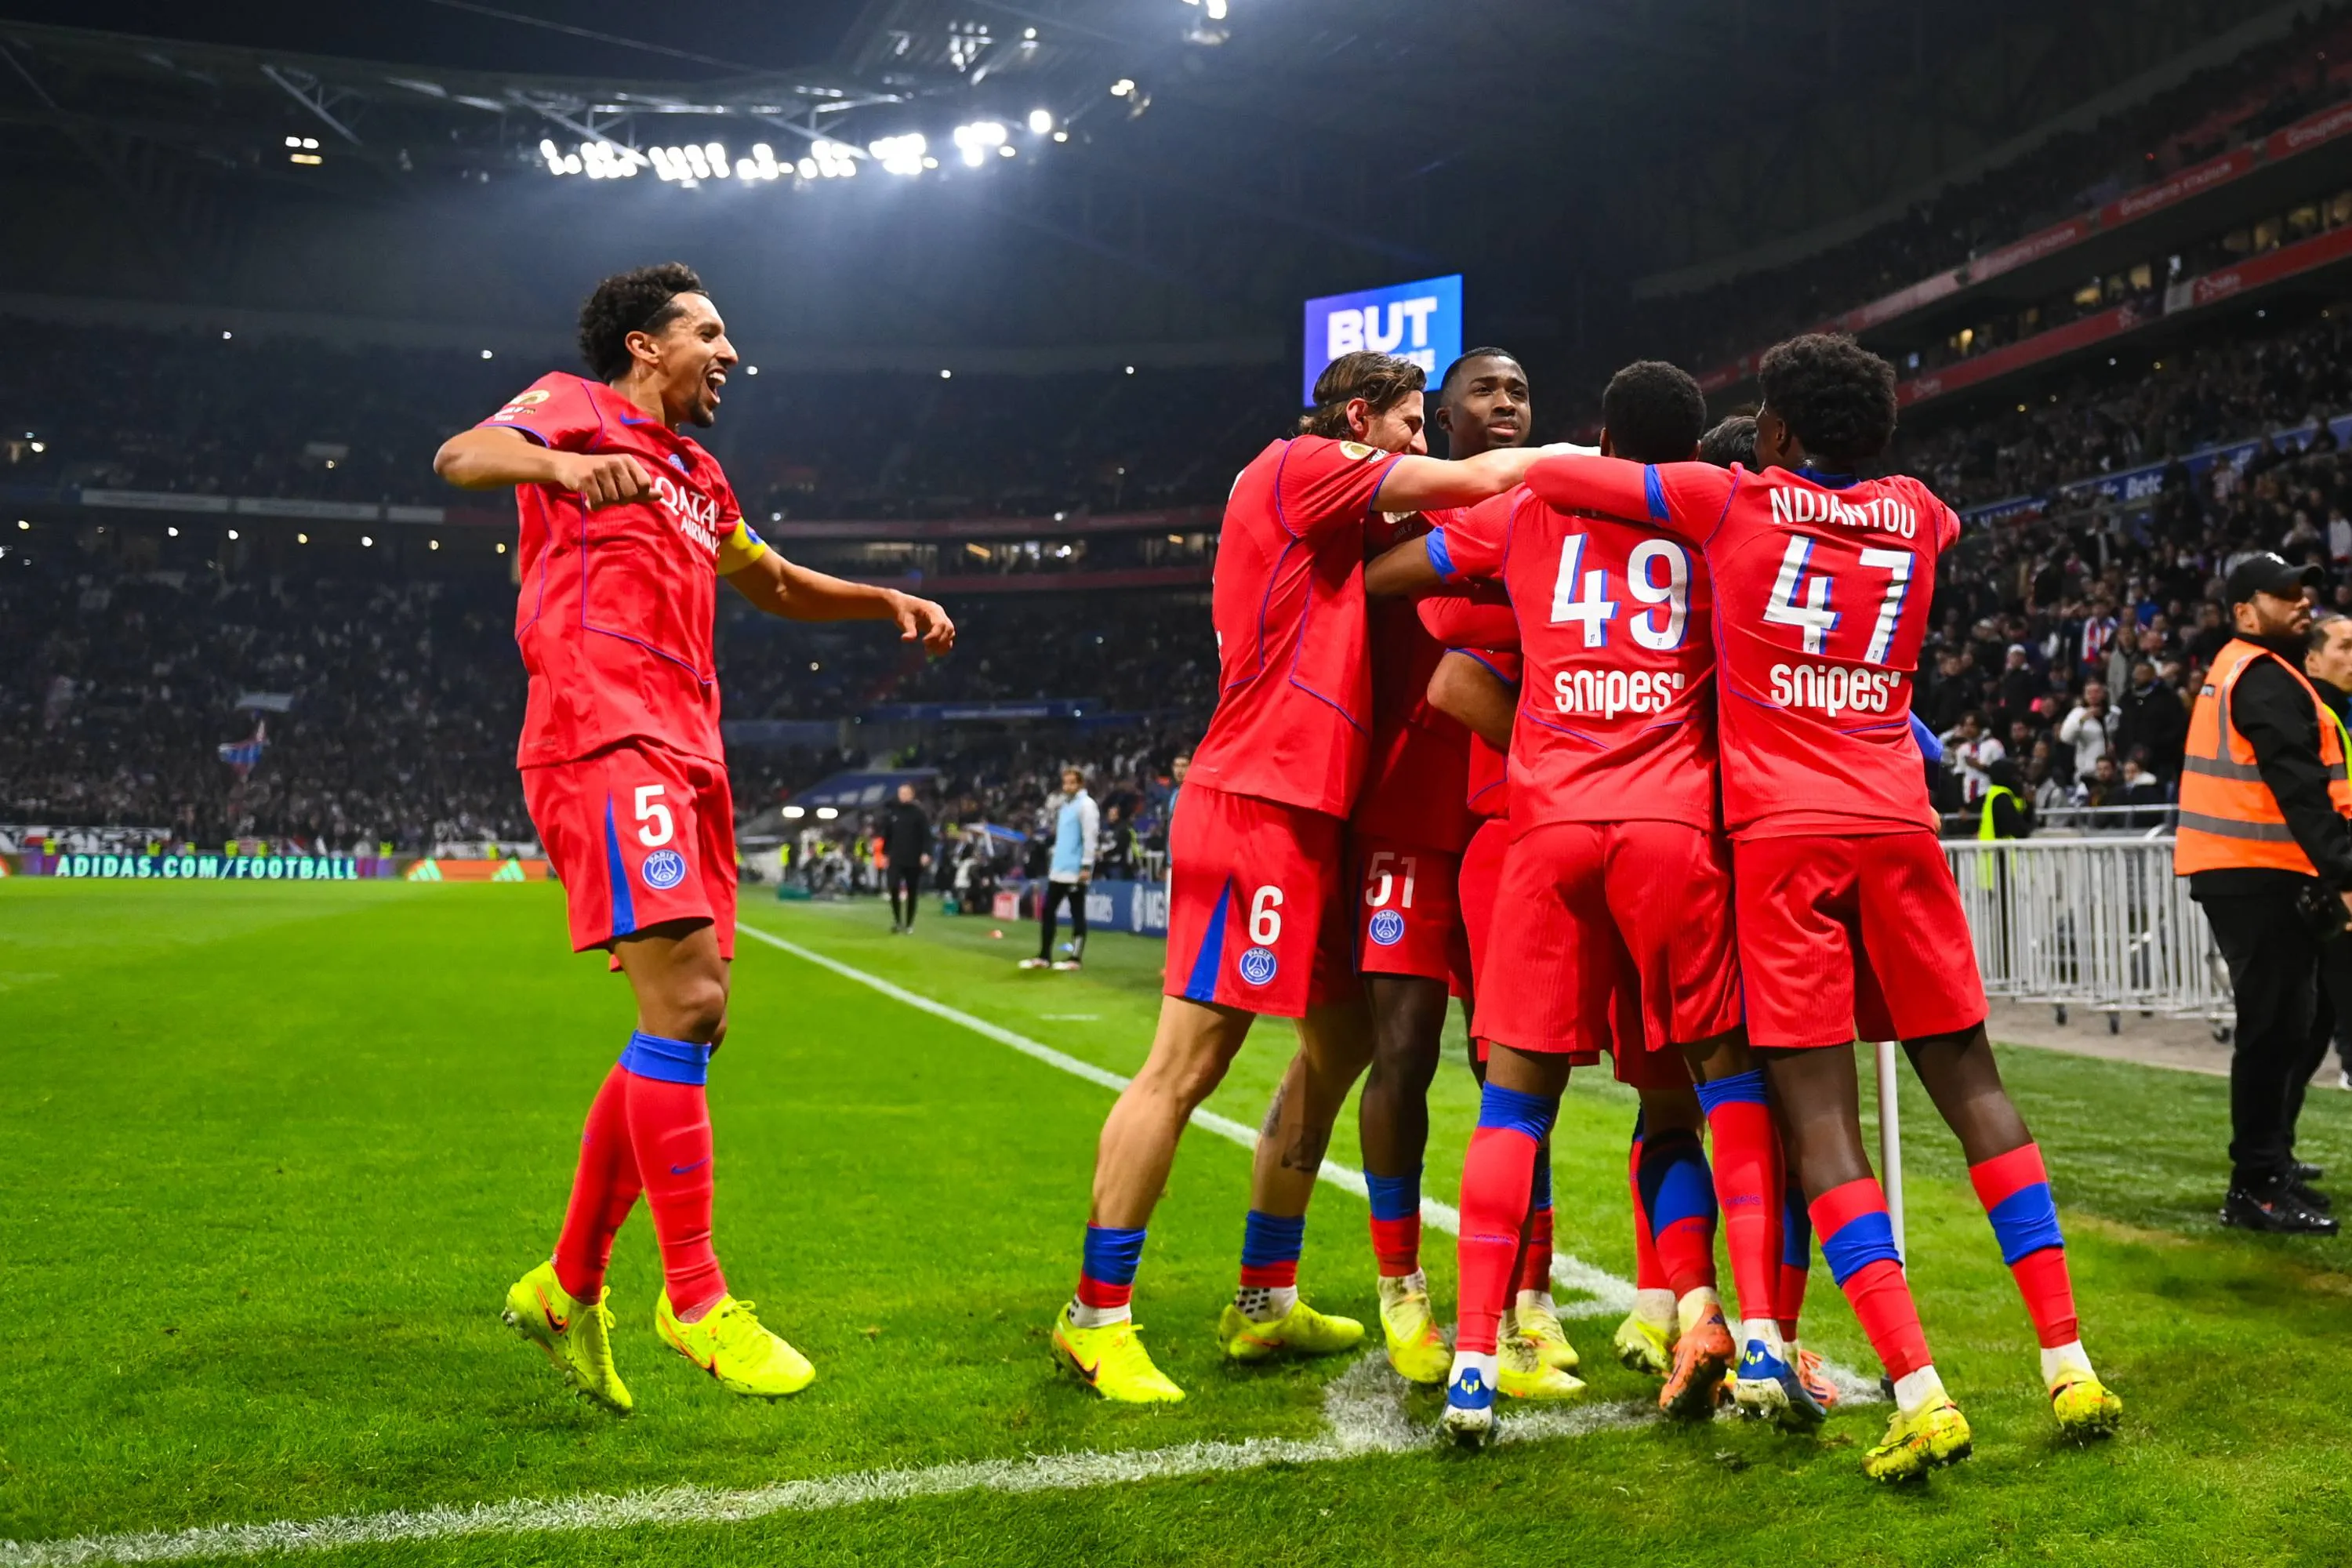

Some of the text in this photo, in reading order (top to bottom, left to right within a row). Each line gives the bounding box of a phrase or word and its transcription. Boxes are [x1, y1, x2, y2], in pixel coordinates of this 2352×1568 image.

[1327, 296, 1438, 361] BUT
[655, 476, 719, 532] QATA
[1769, 486, 1916, 539] NDJANTOU
[1550, 532, 1693, 652] 49
[1762, 535, 1916, 666] 47
[634, 784, 674, 848] 5
[54, 854, 358, 880] ADIDAS.COM/FOOTBALL
[1365, 851, 1417, 909] 51
[1248, 884, 1283, 946] 6
